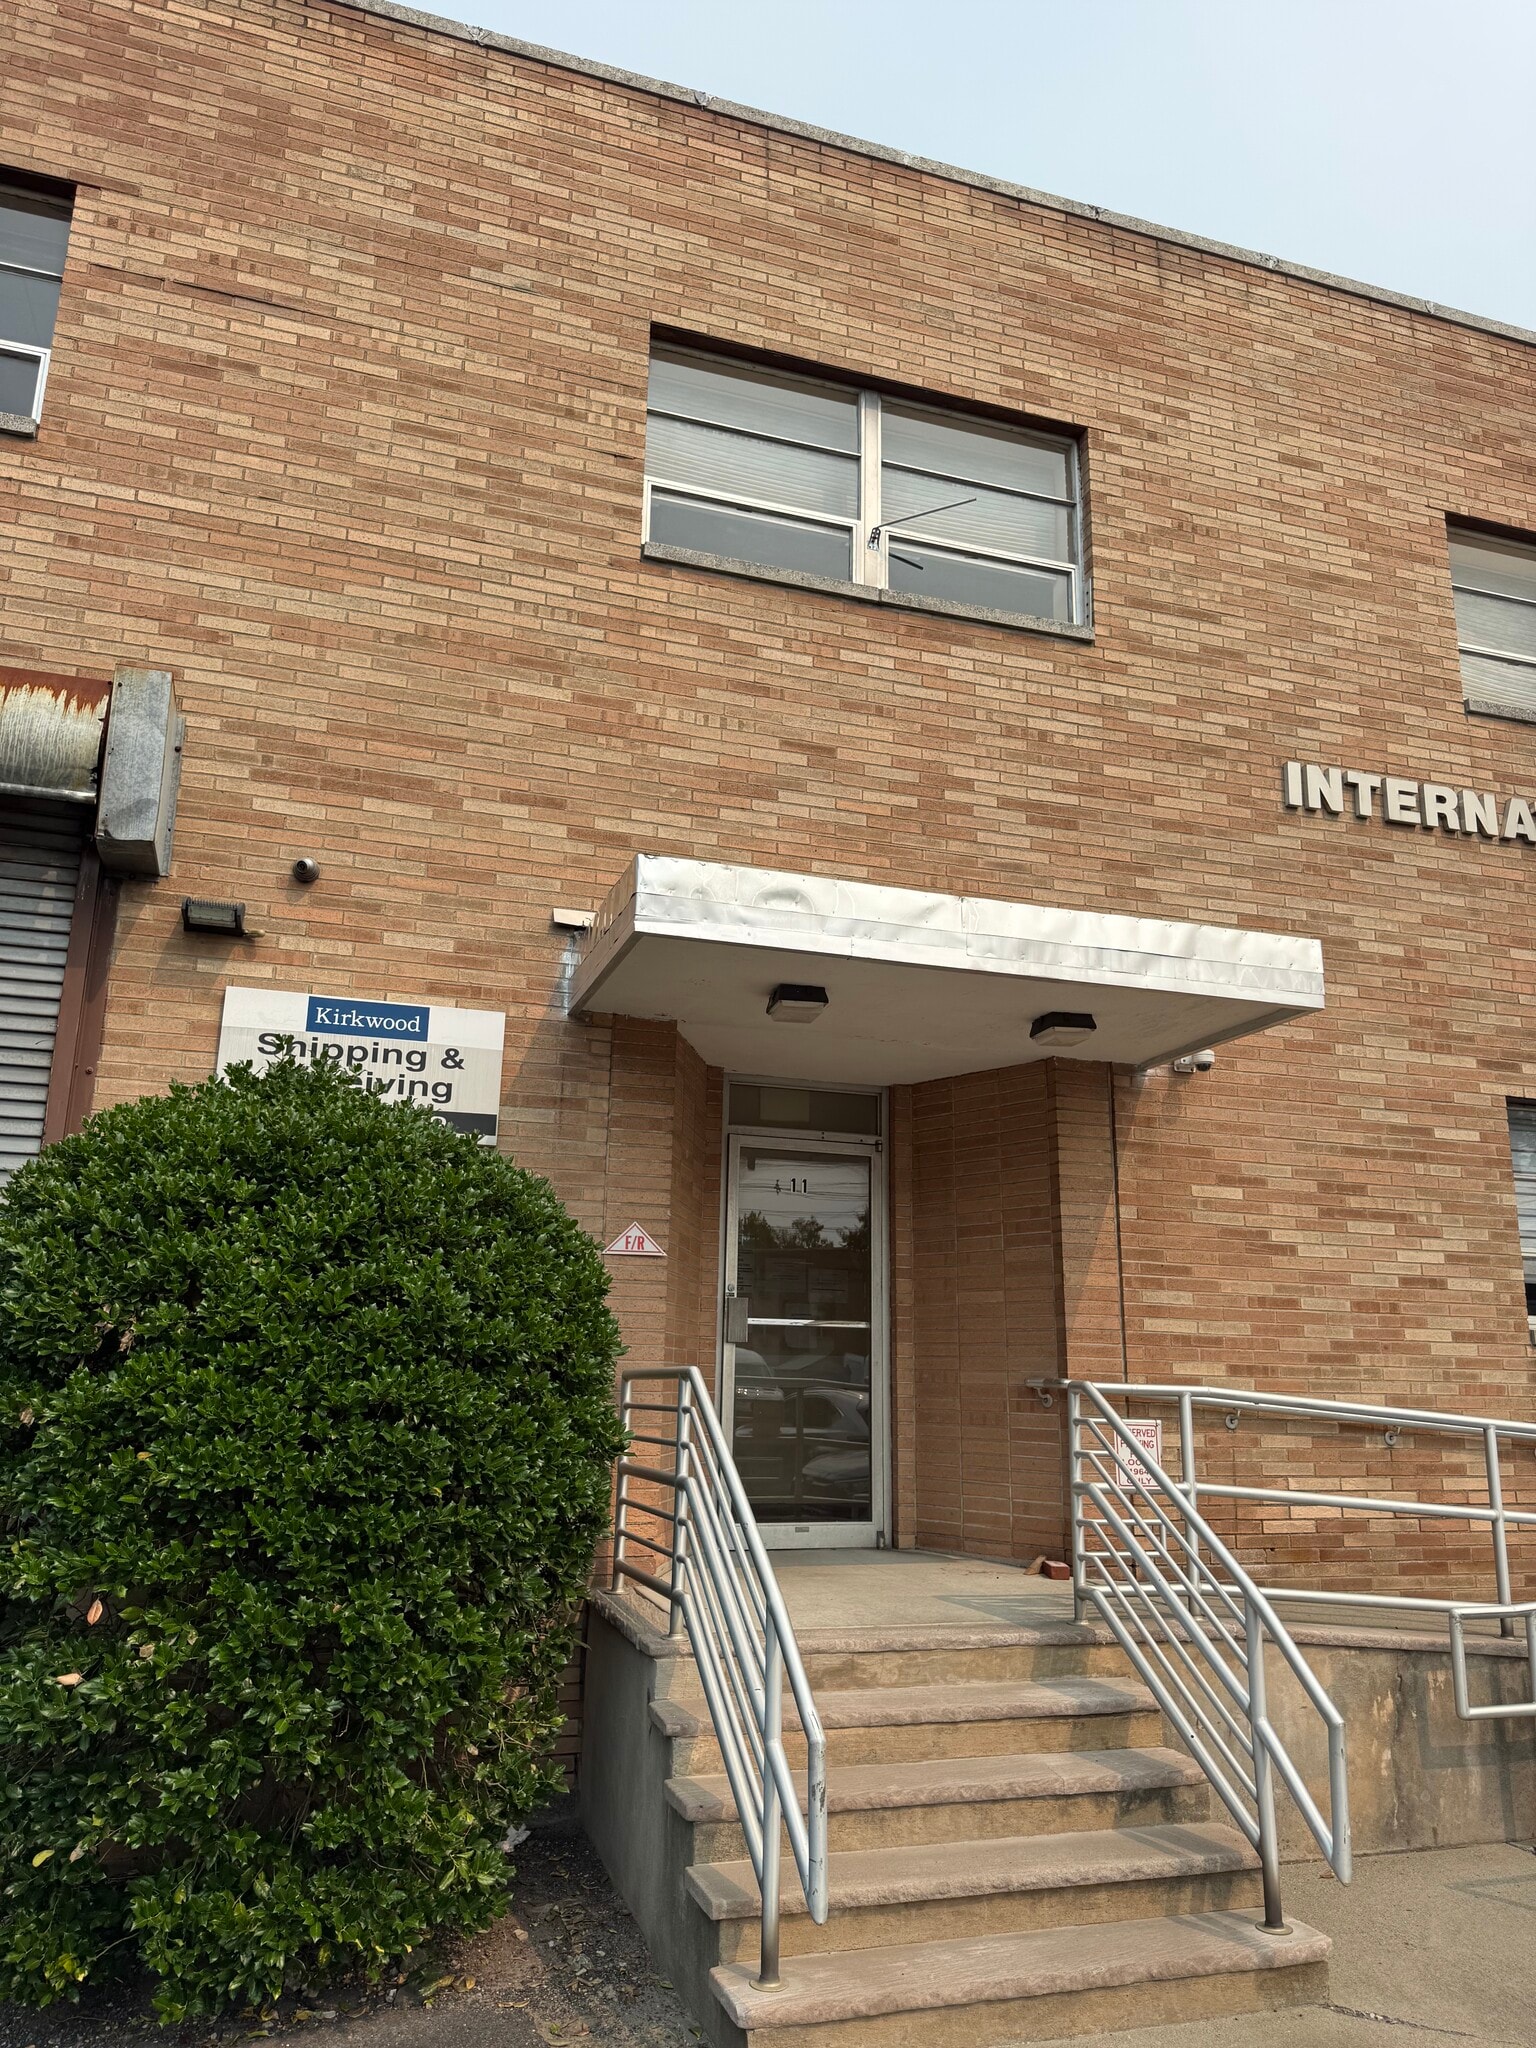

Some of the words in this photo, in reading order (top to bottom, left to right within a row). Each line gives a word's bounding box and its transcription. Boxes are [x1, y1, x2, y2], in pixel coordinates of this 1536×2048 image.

[1284, 761, 1536, 844] INTERNA
[314, 1006, 421, 1033] Kirkwood
[257, 1032, 427, 1073] Shipping
[440, 1047, 466, 1070] &
[624, 1235, 645, 1250] F/R
[1130, 1428, 1156, 1438] ERVED
